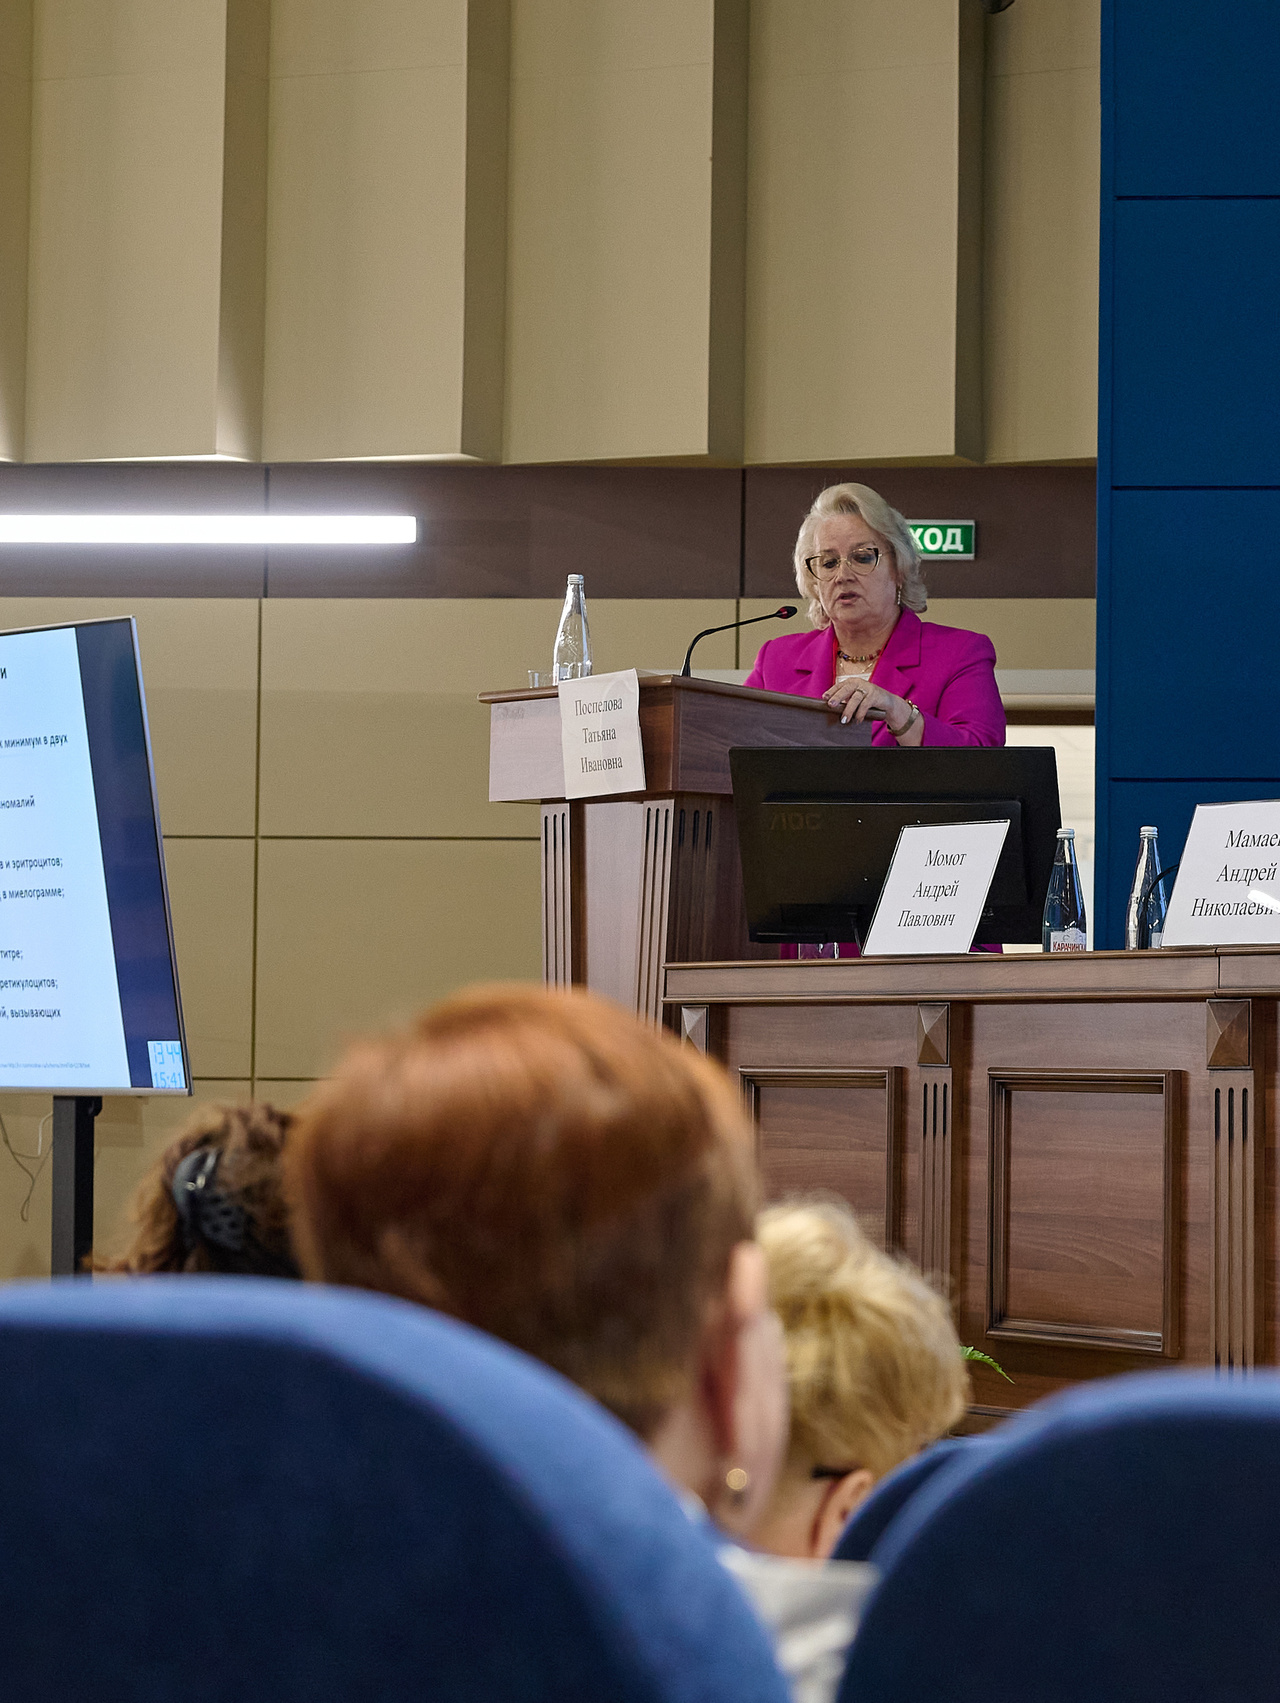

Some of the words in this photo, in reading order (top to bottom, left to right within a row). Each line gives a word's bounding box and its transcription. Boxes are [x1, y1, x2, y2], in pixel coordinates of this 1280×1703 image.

[575, 698, 623, 716] Поспелова
[4, 737, 42, 749] минимум
[43, 736, 48, 745] в
[49, 734, 68, 748] двух
[582, 727, 617, 744] Татьяна
[580, 756, 623, 773] Ивановна
[12, 857, 63, 871] эритроцитов;
[924, 849, 967, 867] Момот
[1216, 862, 1278, 886] Андрей
[8, 887, 65, 900] миелограмме;
[912, 880, 960, 902] Андрей
[897, 909, 956, 927] Павлович
[0, 978, 58, 991] ретикулоцитов;
[10, 1008, 61, 1020] вызывающих
[154, 1072, 183, 1088] 15:41
